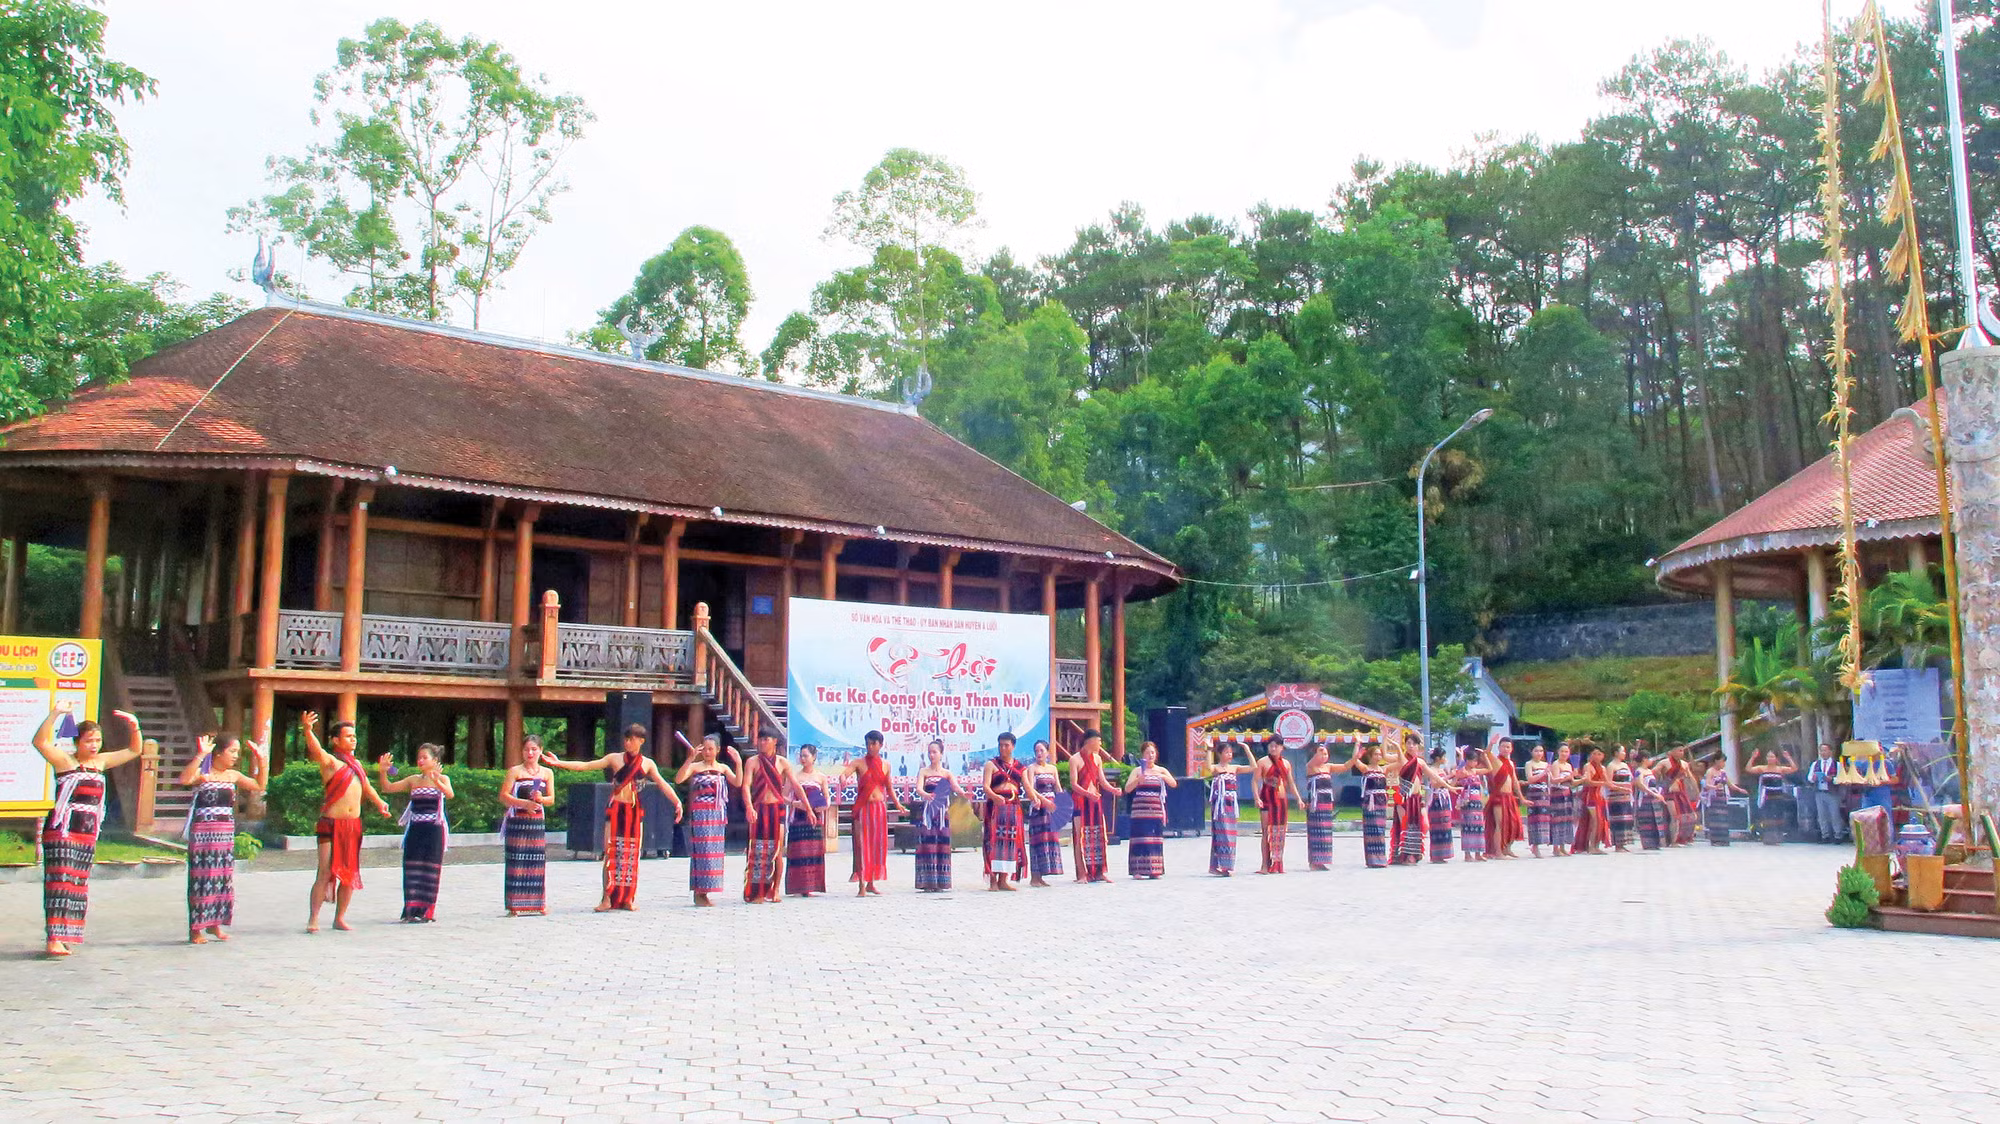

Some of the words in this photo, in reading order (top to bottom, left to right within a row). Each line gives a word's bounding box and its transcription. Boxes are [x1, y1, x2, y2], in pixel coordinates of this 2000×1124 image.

[903, 617, 917, 626] THAO
[928, 619, 938, 628] BAN
[13, 645, 38, 660] LỊCH
[847, 688, 867, 703] Ka
[872, 689, 917, 709] Coong
[961, 719, 976, 733] Tu
